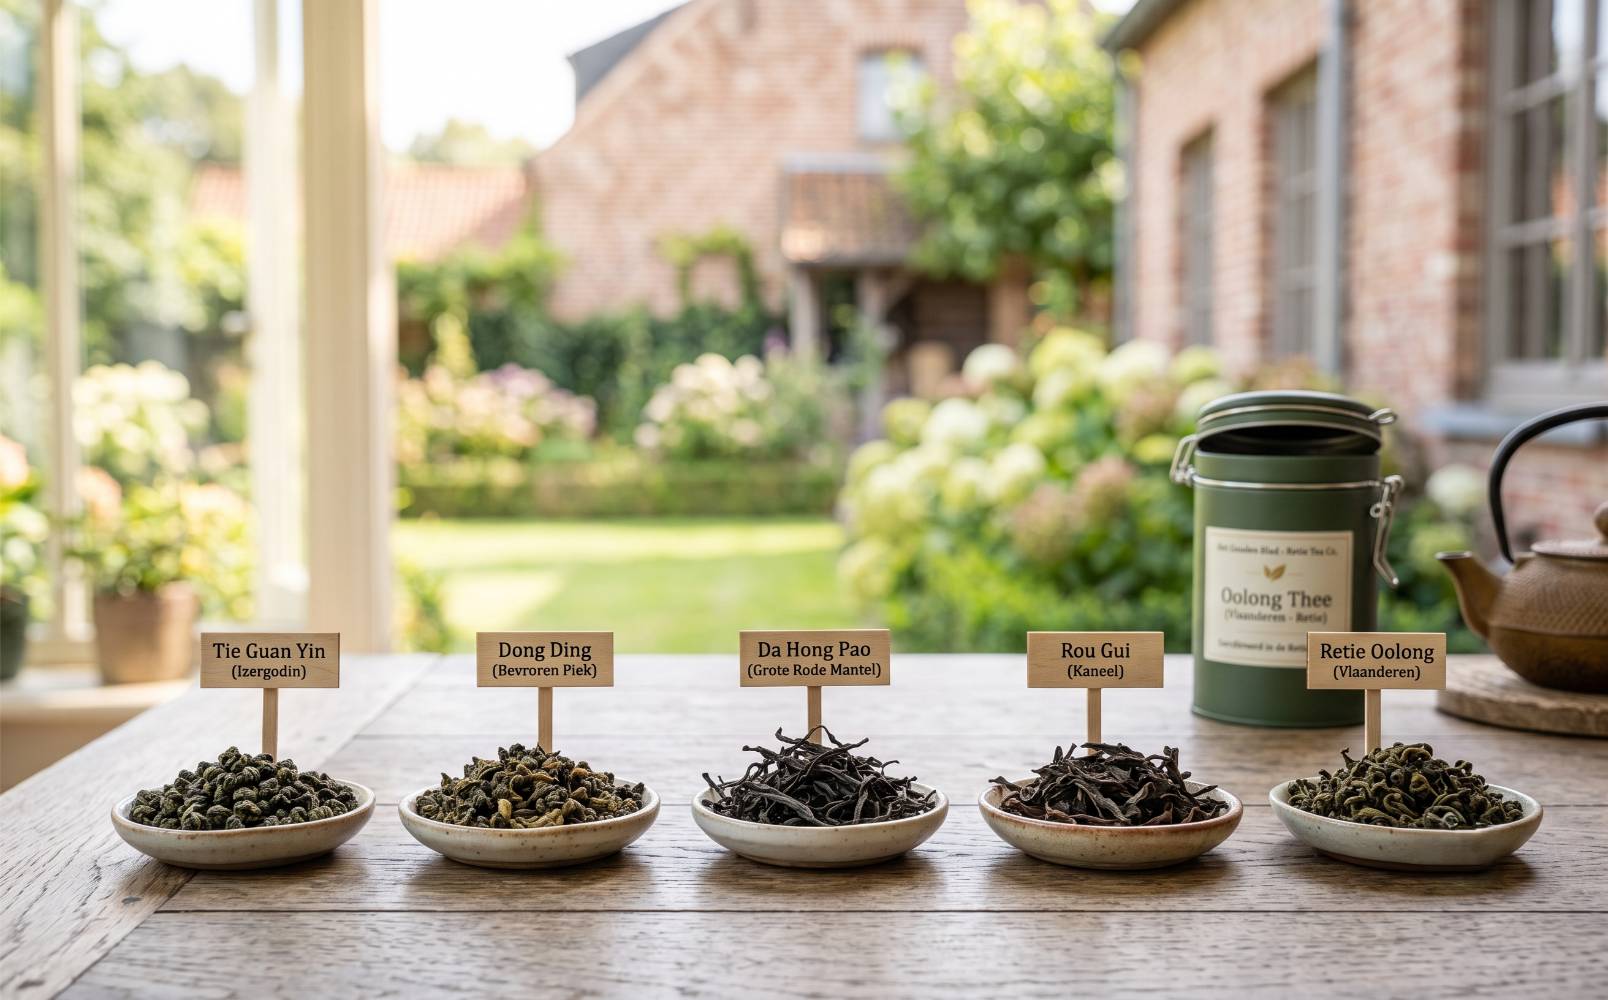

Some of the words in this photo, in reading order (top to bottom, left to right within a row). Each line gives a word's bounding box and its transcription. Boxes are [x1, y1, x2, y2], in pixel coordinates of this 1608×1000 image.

[1221, 587, 1282, 611] Oolong
[1287, 590, 1333, 608] Thee
[1224, 607, 1286, 622] (Vlaanderen
[1295, 611, 1328, 625] Retie)
[212, 642, 241, 659] Tie
[245, 642, 292, 659] Guan
[295, 642, 326, 659] Yin
[498, 641, 546, 662] Dong
[549, 641, 592, 662] Ding
[757, 641, 782, 658] Da
[786, 641, 834, 661] Hong
[838, 641, 871, 657] Pao
[1060, 642, 1096, 659] Rou
[1100, 642, 1131, 659] Gui
[1320, 642, 1366, 660] Retie
[1370, 642, 1435, 664] Oolong
[231, 664, 307, 681] (Izergodin)
[492, 663, 560, 680] (Bevroren
[563, 663, 597, 680] Piek)
[747, 663, 790, 679] (Grote
[793, 663, 827, 677] Rode
[830, 662, 882, 679] Mantel)
[1067, 663, 1125, 681] (Kaneel)
[1333, 664, 1421, 682] (Vlaanderen)
